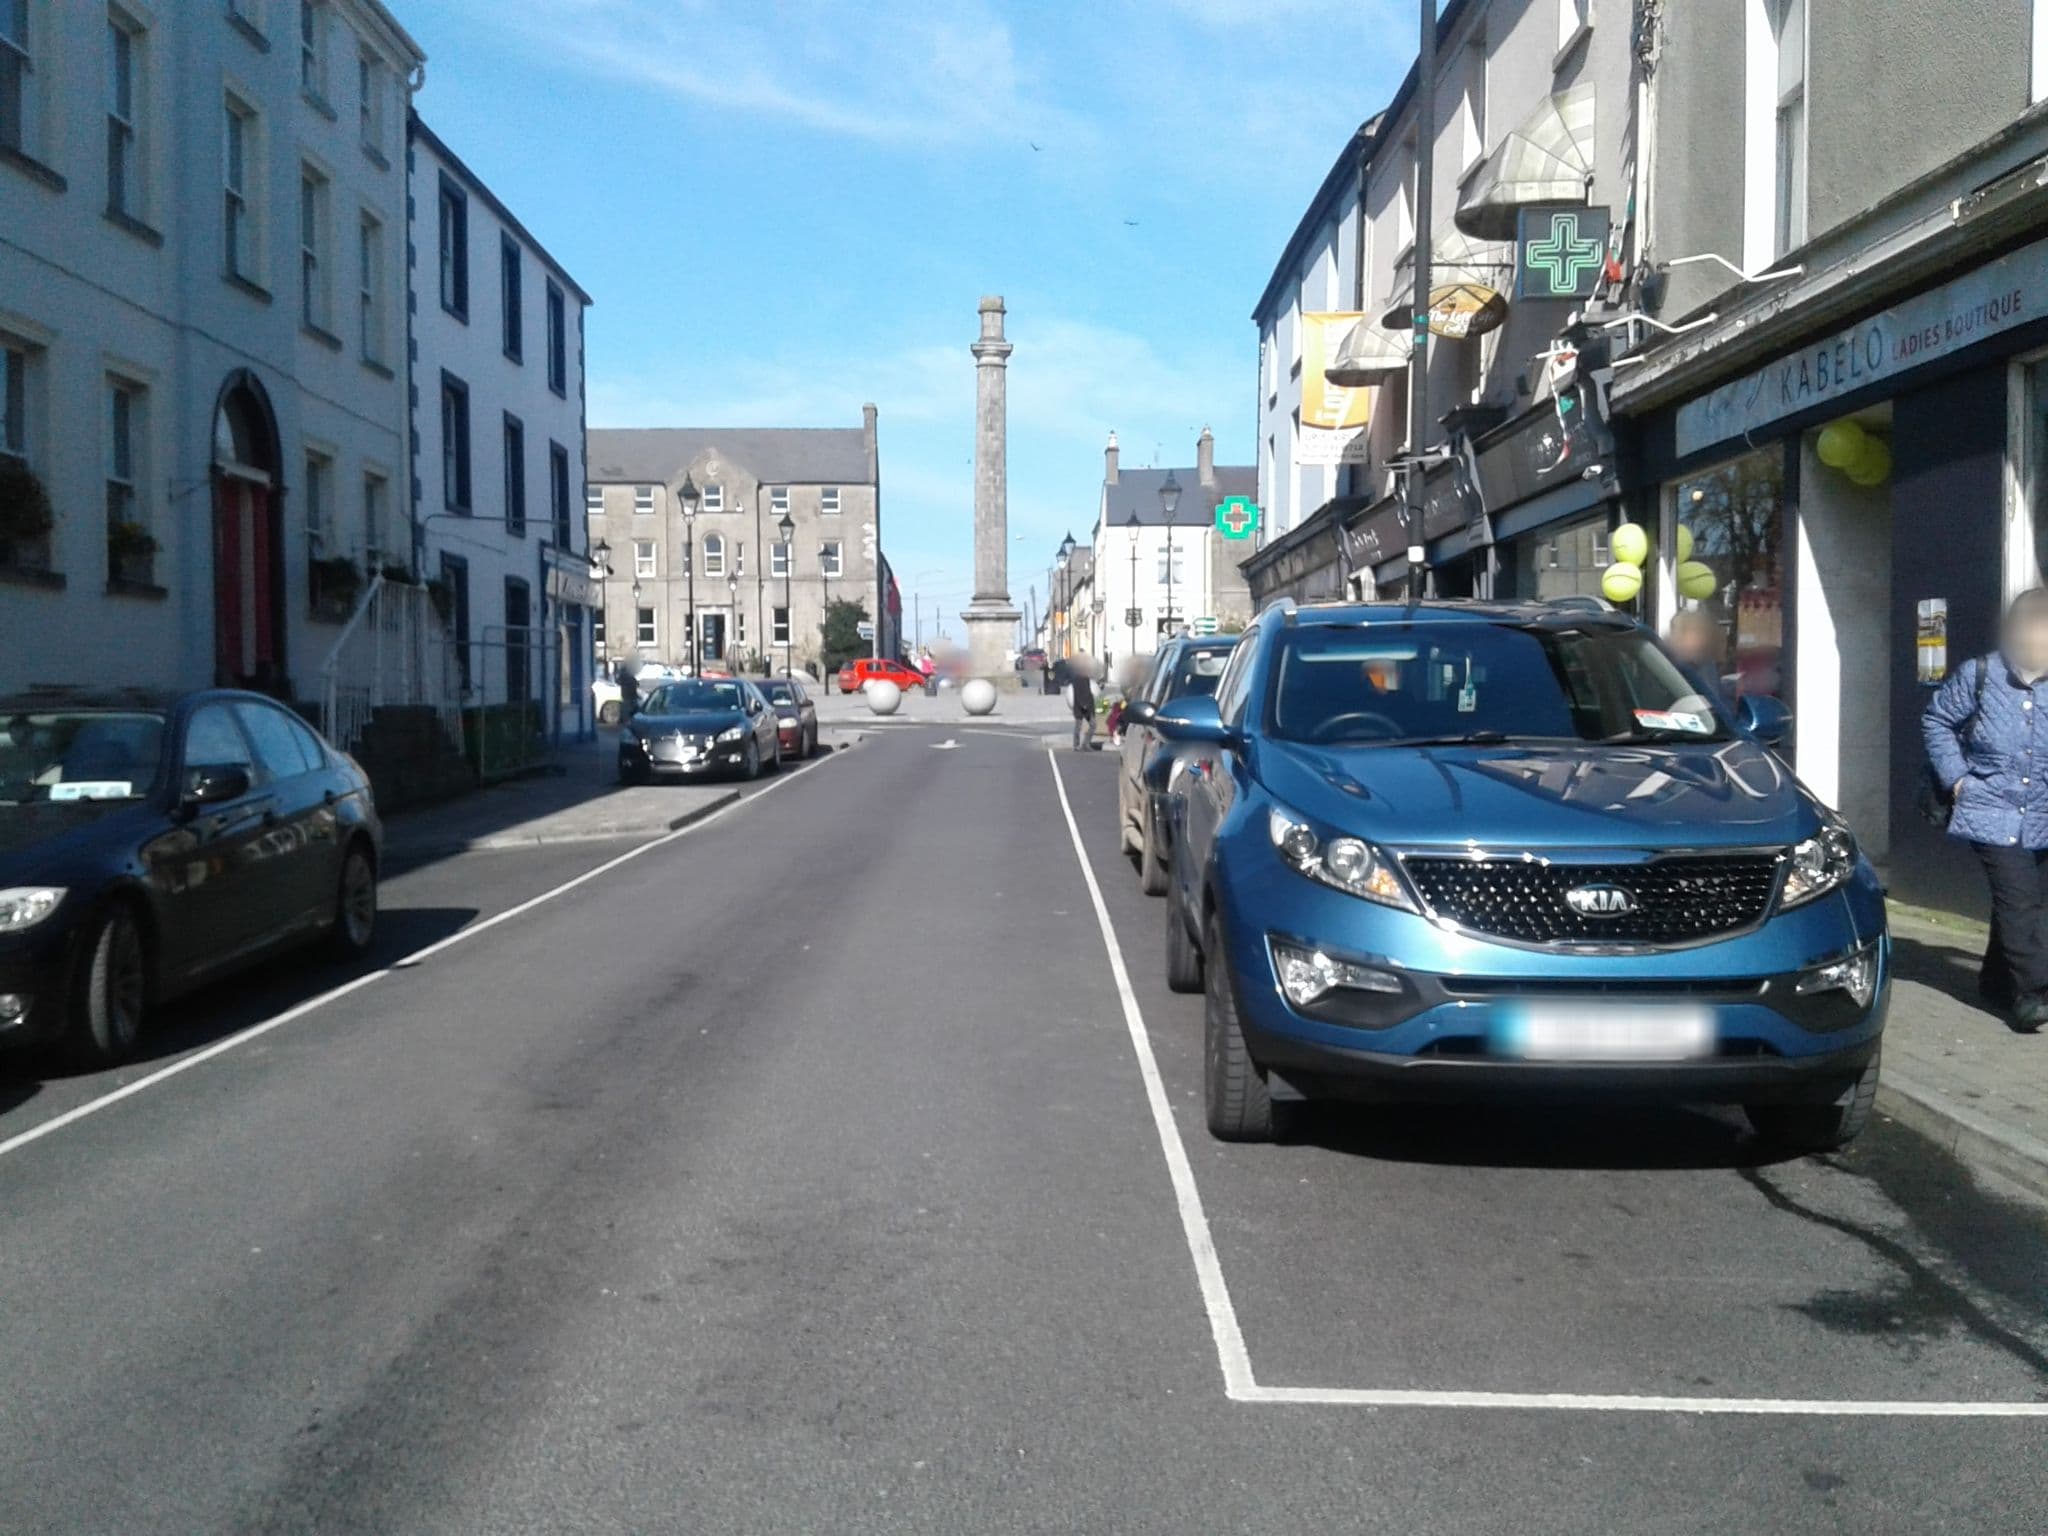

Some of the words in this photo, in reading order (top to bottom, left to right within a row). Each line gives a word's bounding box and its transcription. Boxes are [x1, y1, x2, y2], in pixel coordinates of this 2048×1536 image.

[1780, 325, 1882, 405] KABELO
[1892, 323, 1940, 361] LADIES
[1945, 289, 2022, 341] BOUTIQUE
[1580, 890, 1628, 911] KIA
